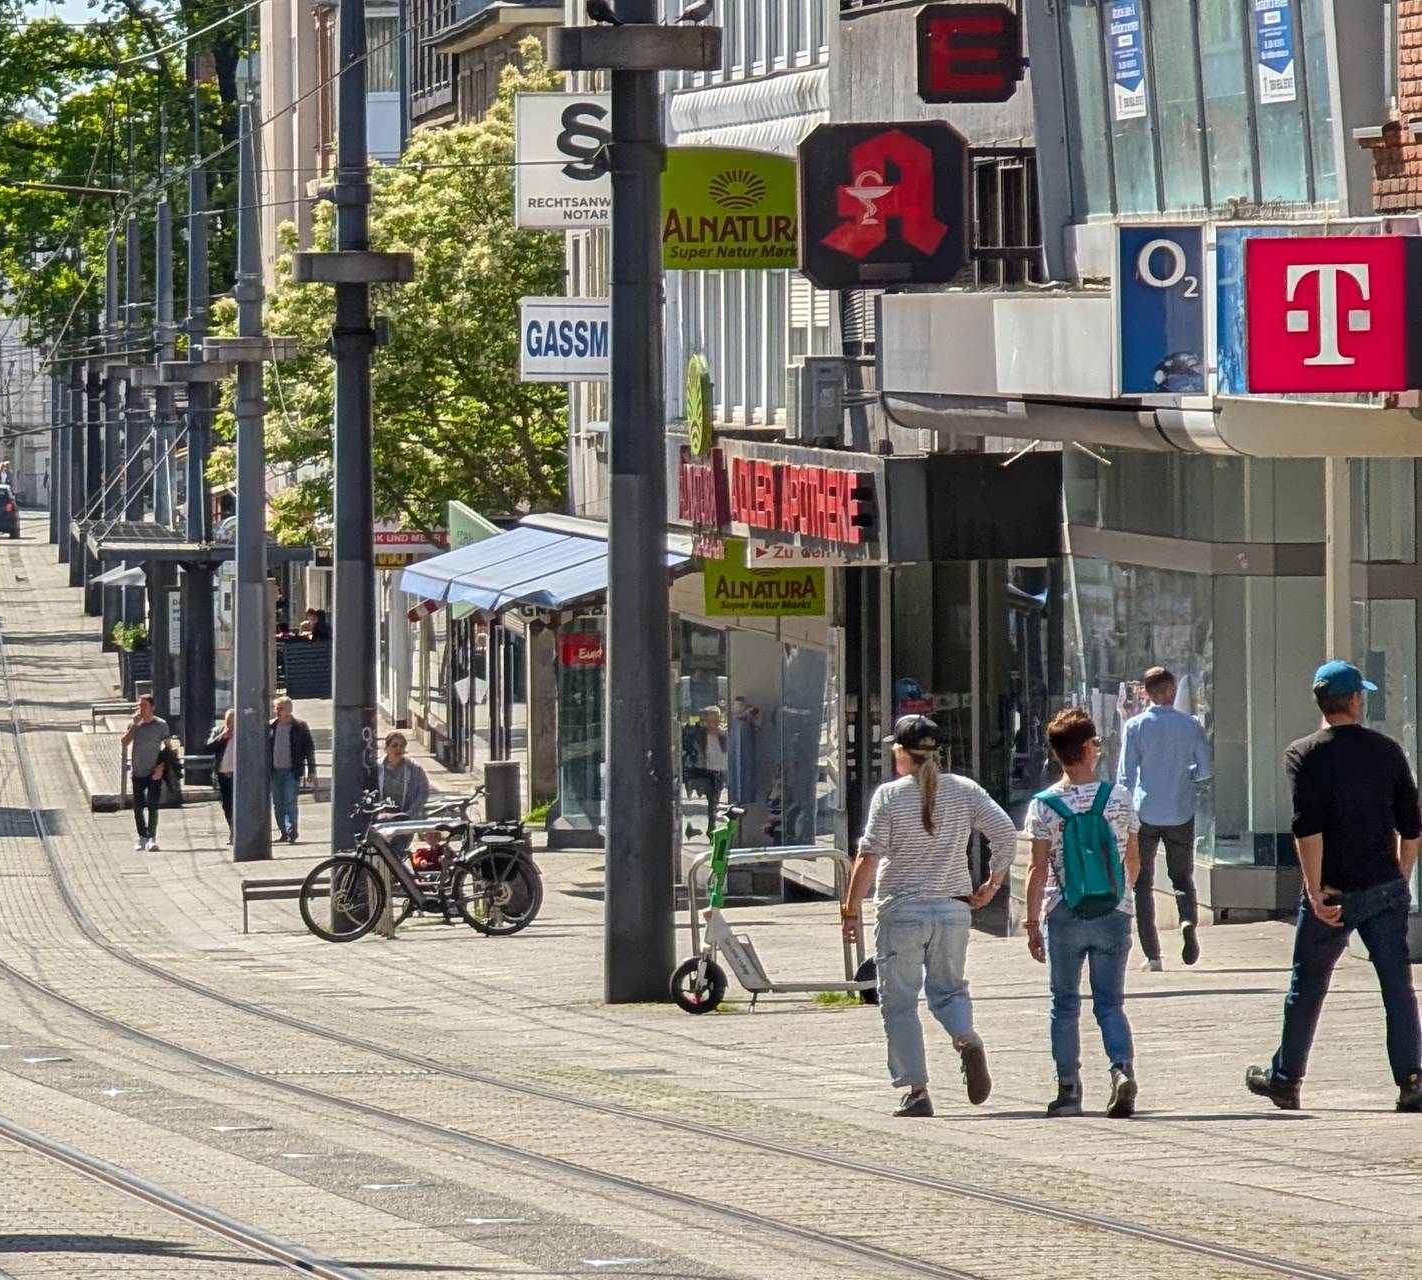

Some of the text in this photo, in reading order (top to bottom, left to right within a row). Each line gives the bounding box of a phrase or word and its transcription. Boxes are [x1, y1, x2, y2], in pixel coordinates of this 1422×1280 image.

[930, 17, 1004, 91] E
[563, 209, 608, 220] NOTAR
[671, 246, 713, 260] Super
[716, 246, 759, 258] Natur
[1286, 263, 1370, 366] T
[730, 457, 774, 530] ADLER
[781, 463, 861, 545] APOTHEKE
[714, 575, 818, 600] ALNATURA
